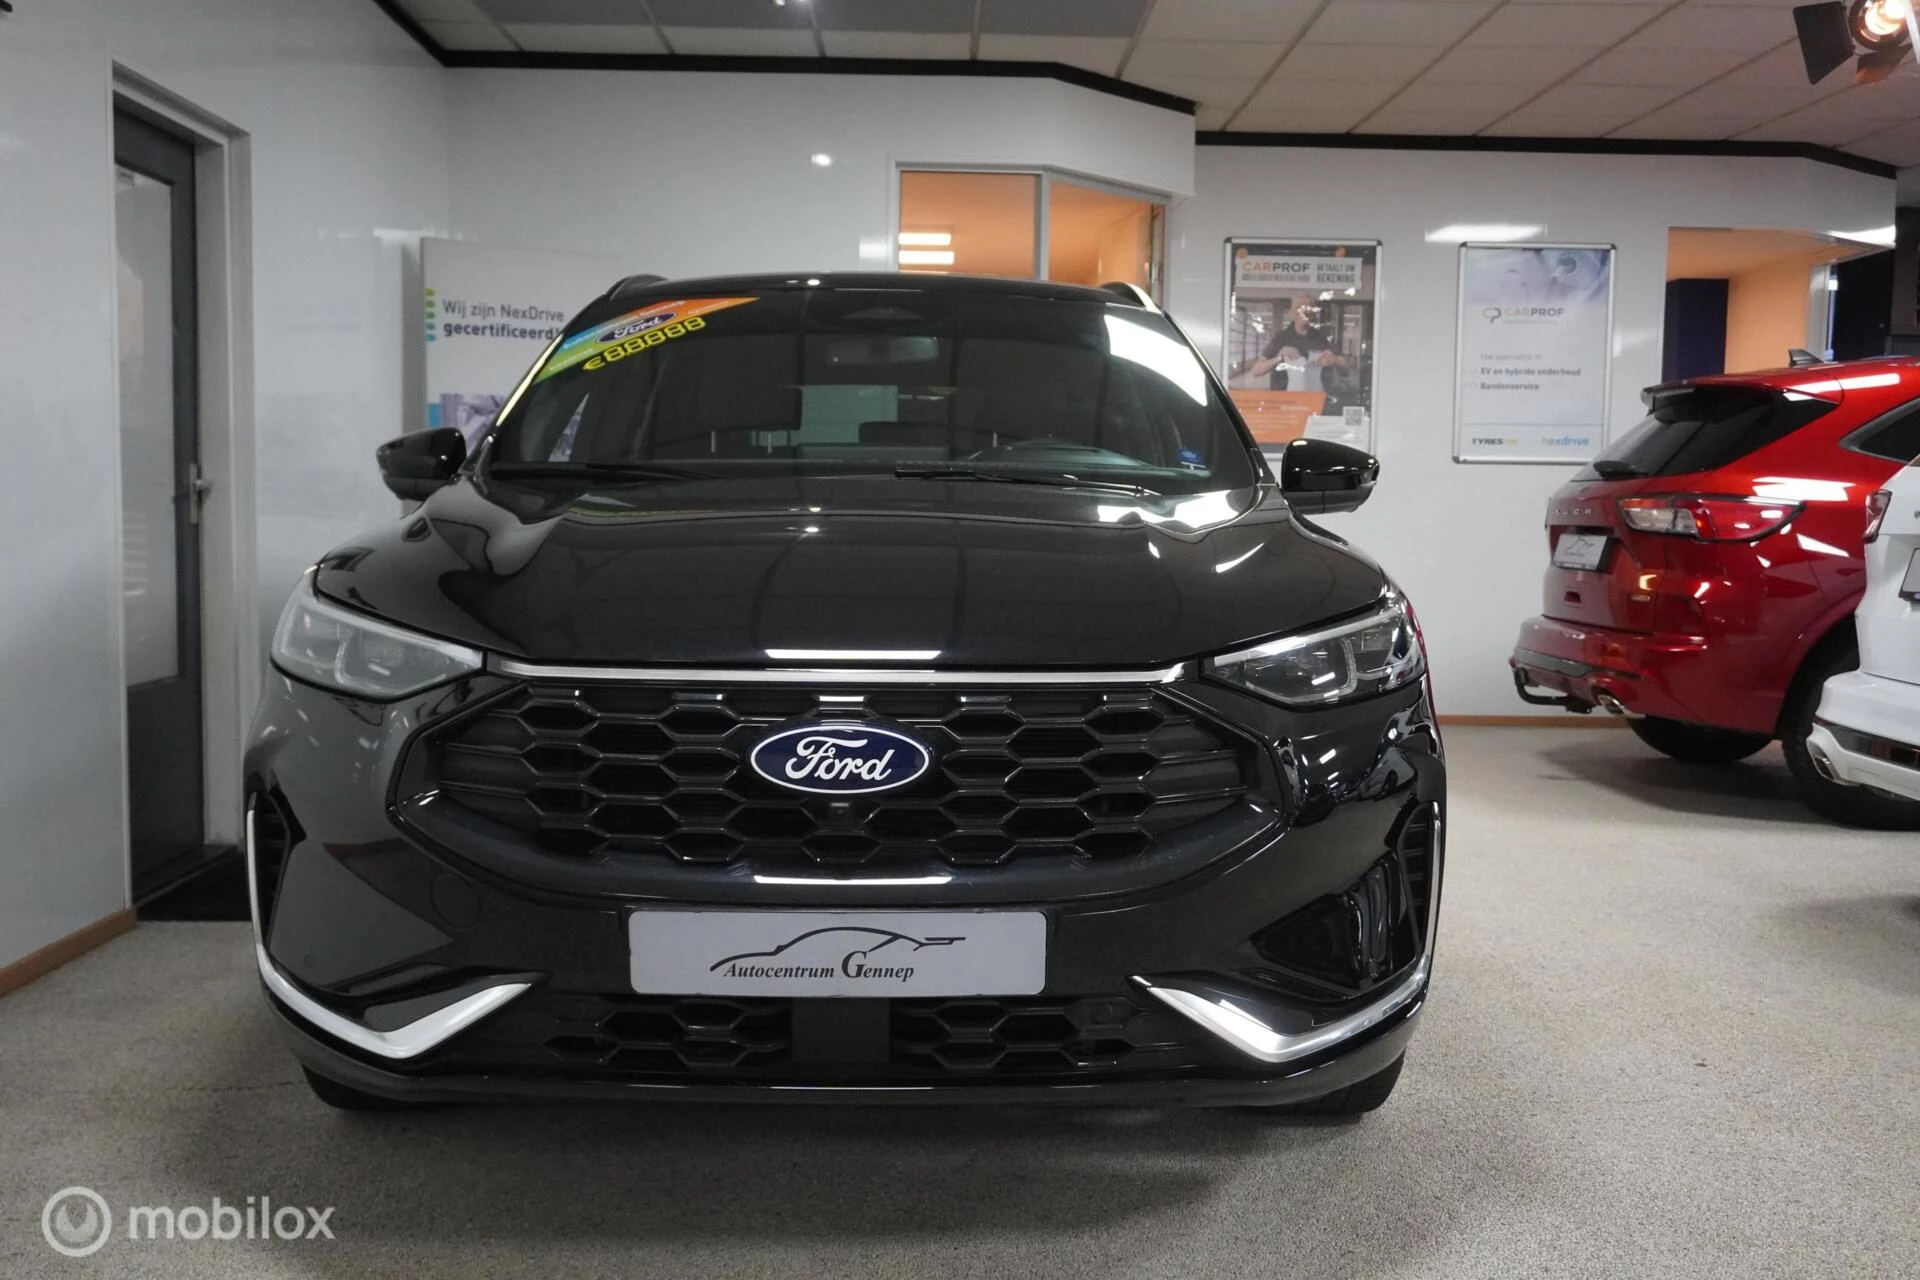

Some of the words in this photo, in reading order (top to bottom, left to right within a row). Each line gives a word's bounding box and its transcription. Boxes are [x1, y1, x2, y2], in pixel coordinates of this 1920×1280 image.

[1242, 262, 1311, 273] CARPROF
[442, 299, 466, 319] Wij
[470, 302, 496, 320] zijn
[500, 304, 564, 321] NexDrive
[1504, 307, 1565, 317] CARPROF
[612, 315, 665, 339] Ford
[1480, 367, 1492, 376] EV
[785, 736, 896, 781] Ford
[724, 962, 835, 979] Autocentrum
[841, 950, 915, 982] Gennep
